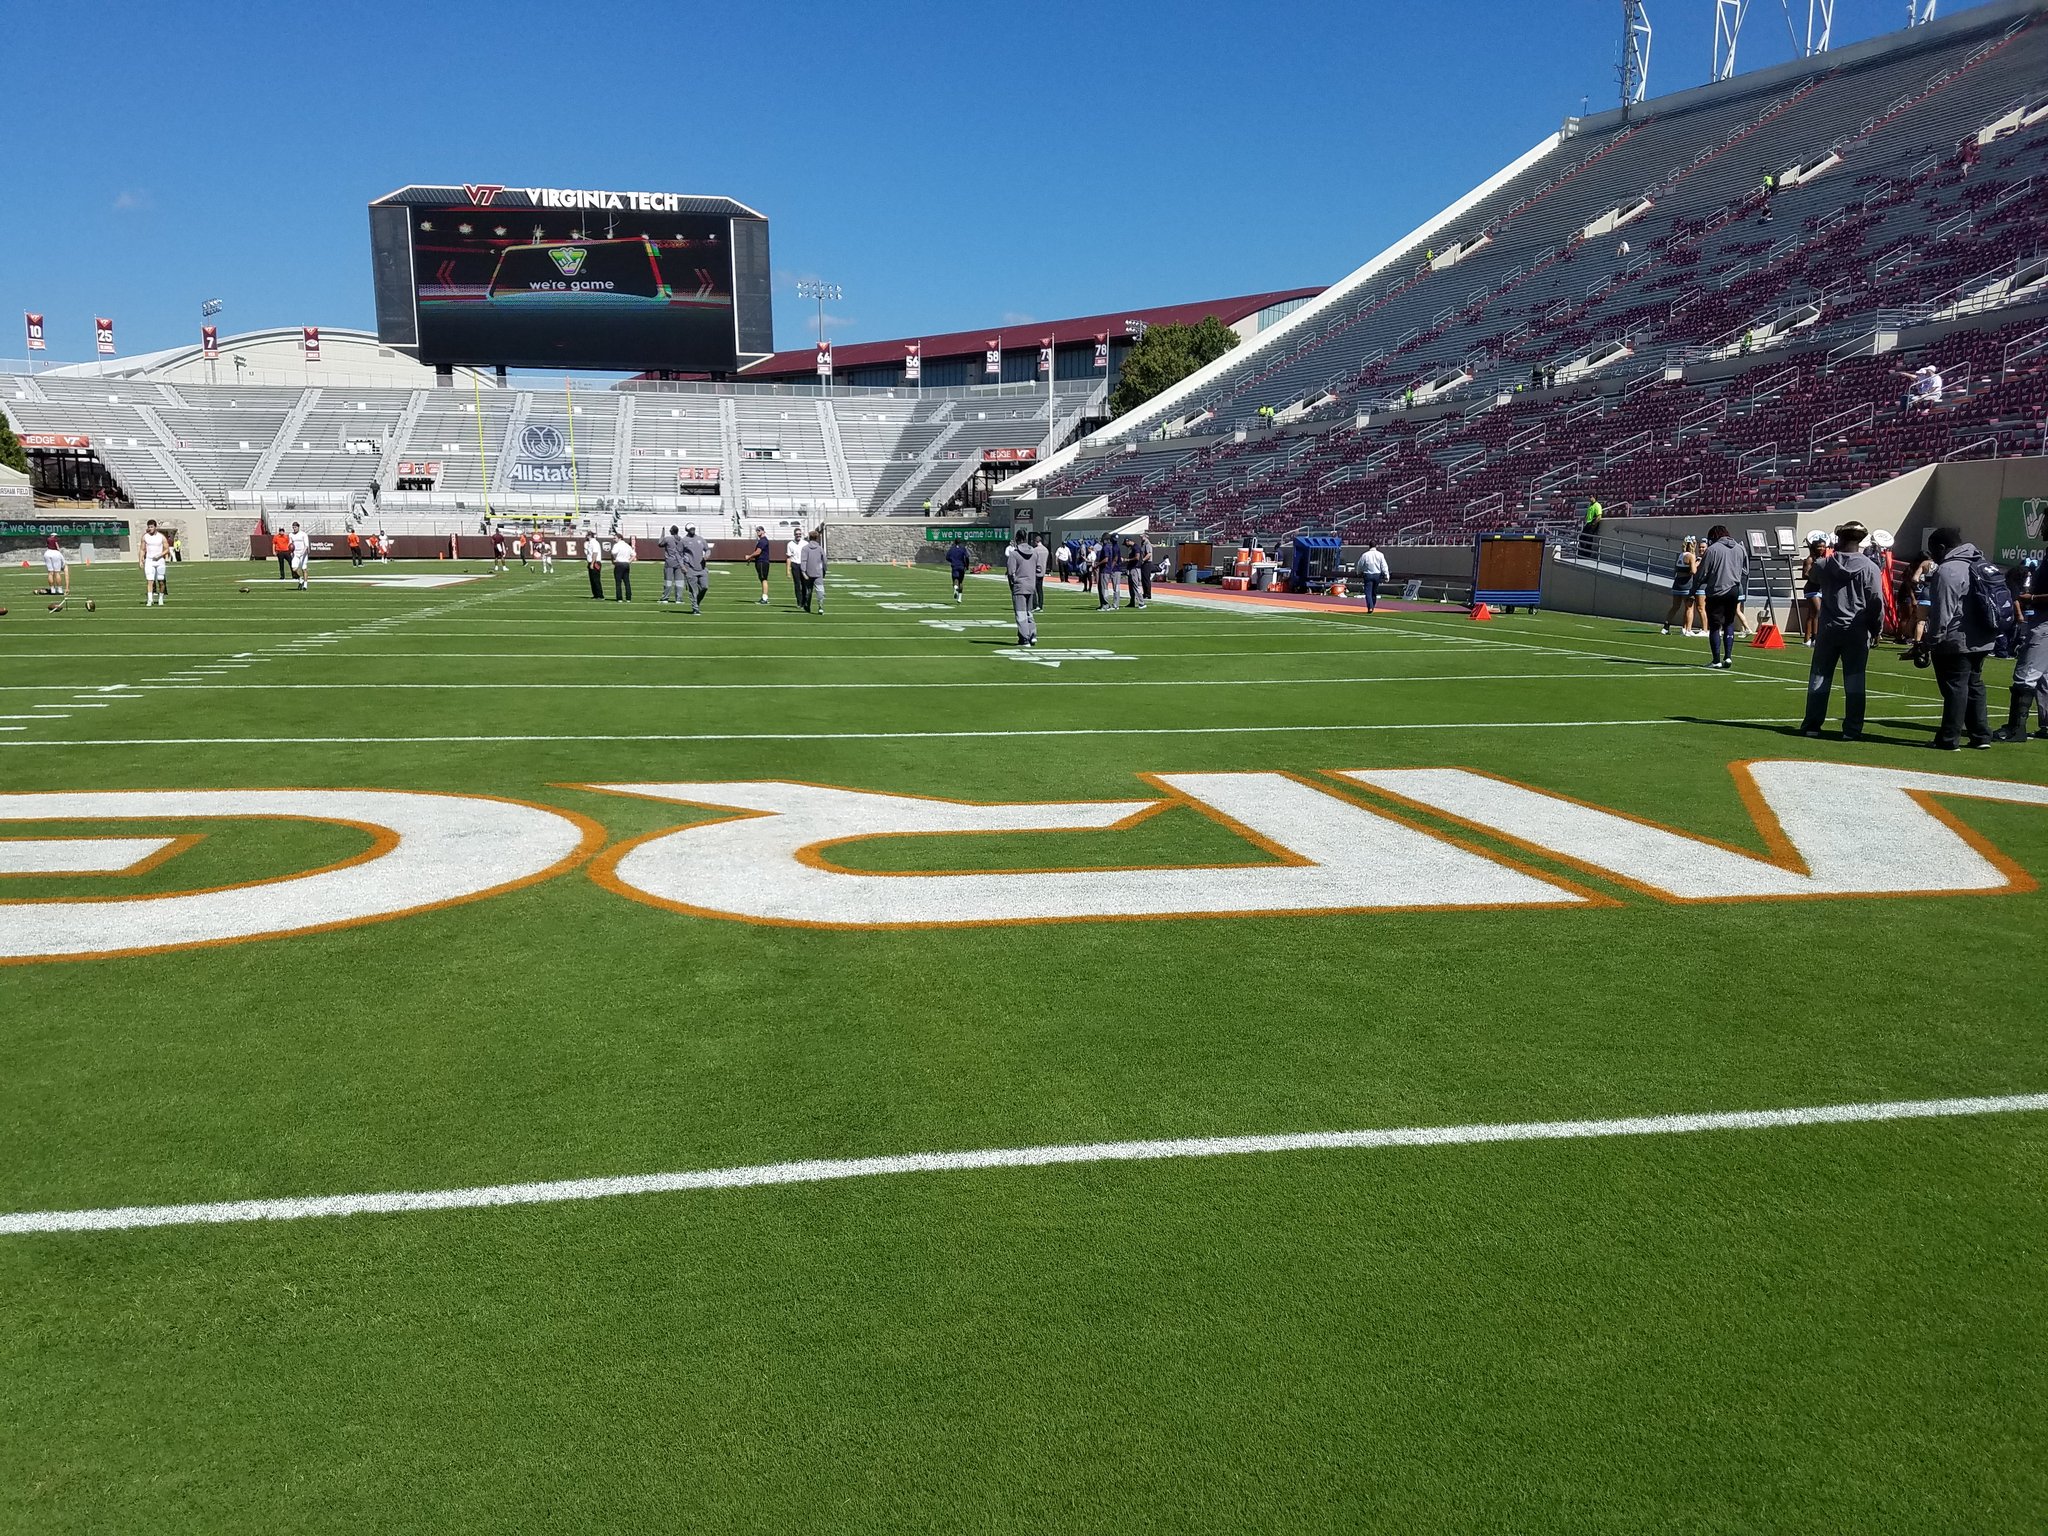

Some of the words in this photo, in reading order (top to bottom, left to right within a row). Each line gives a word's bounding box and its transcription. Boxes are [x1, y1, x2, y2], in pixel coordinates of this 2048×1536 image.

[463, 184, 505, 206] VT
[525, 188, 623, 209] VIRGINIA
[626, 191, 679, 211] TECH
[529, 280, 567, 290] we're
[570, 281, 615, 291] game
[29, 325, 42, 338] 10
[97, 329, 113, 342] 25
[206, 336, 215, 349] 7
[986, 350, 999, 362] 58
[1095, 344, 1107, 356] 78
[817, 352, 830, 364] 64
[906, 355, 919, 368] 56
[63, 436, 80, 445] VT
[1016, 449, 1030, 457] VT
[508, 463, 579, 482] Allstate
[1018, 509, 1031, 517] ACC
[10, 522, 34, 533] we're
[39, 524, 70, 535] game
[73, 522, 87, 533] for
[941, 529, 962, 538] we're
[964, 531, 984, 540] game
[2001, 545, 2027, 560] we're
